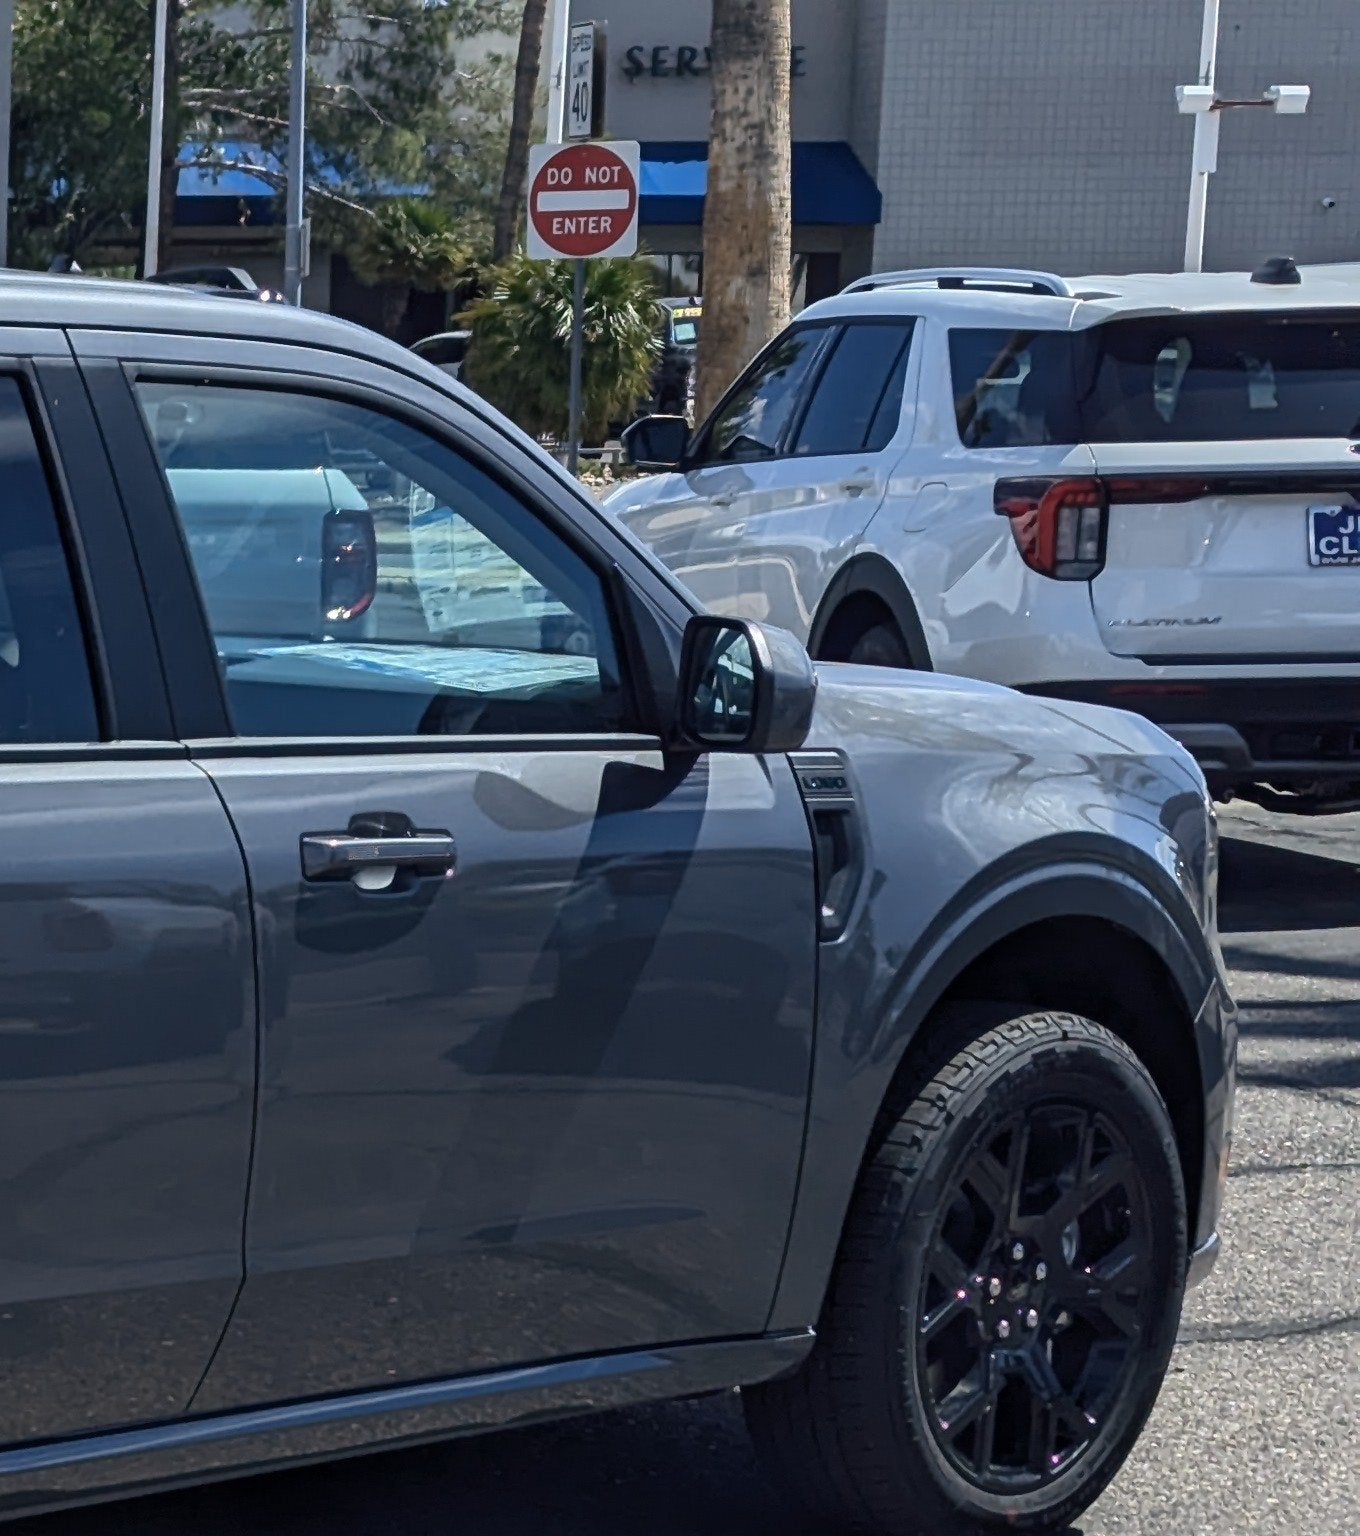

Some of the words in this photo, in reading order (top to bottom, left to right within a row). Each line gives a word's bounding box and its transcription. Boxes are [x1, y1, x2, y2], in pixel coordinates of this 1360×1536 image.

[572, 81, 589, 122] 40
[546, 167, 573, 185] DO
[584, 165, 622, 184] NOT
[551, 216, 613, 235] ENTER
